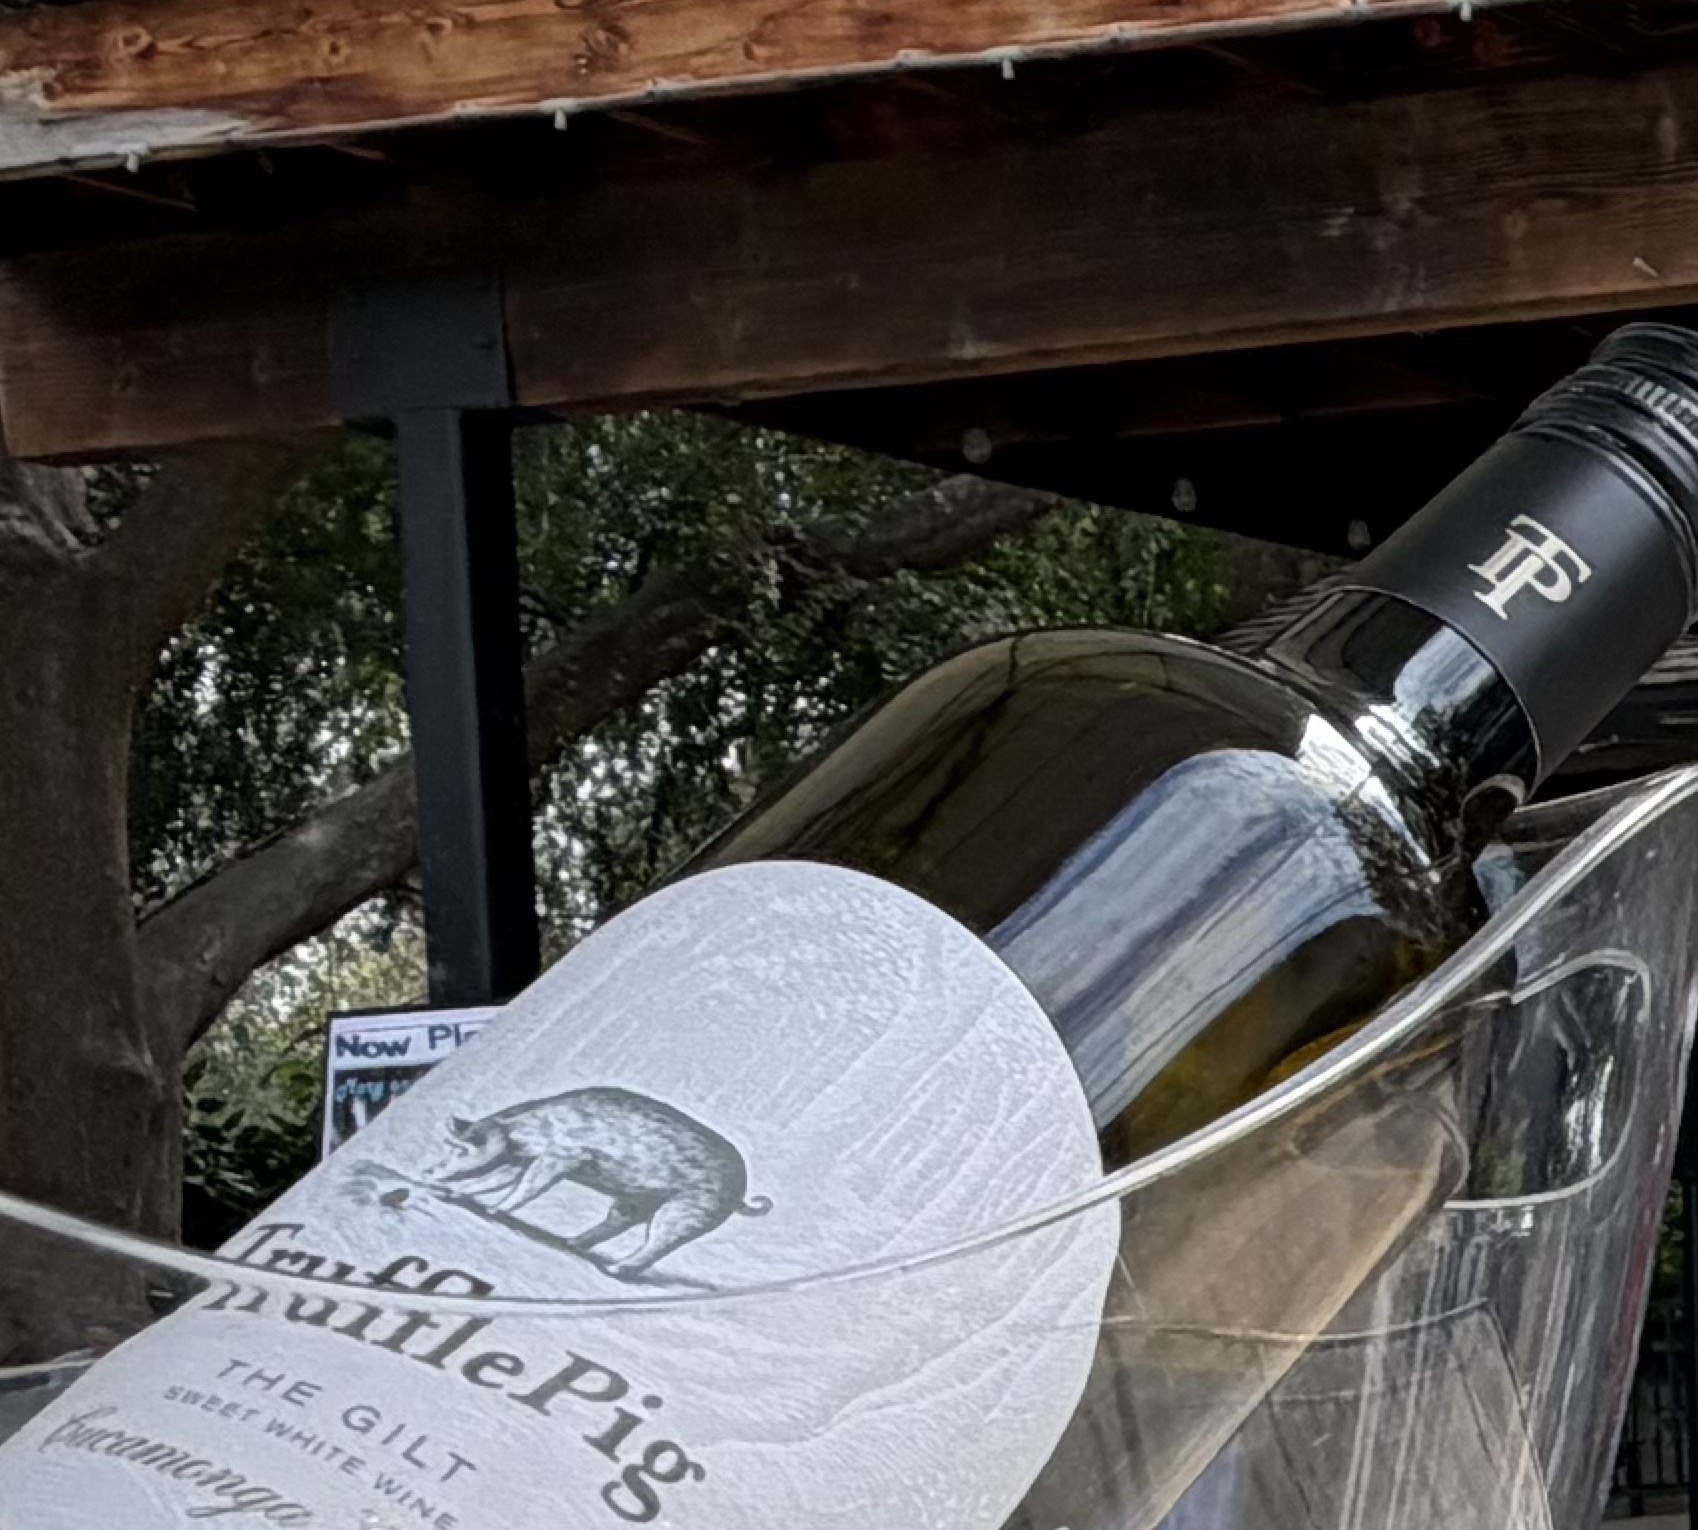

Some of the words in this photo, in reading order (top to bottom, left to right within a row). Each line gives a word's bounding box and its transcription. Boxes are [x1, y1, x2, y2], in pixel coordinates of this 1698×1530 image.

[336, 1034, 411, 1058] Now
[163, 1385, 259, 1422] SWEET
[266, 1416, 367, 1477] WHITE
[216, 1359, 323, 1407] THE
[341, 1404, 477, 1483] GILT
